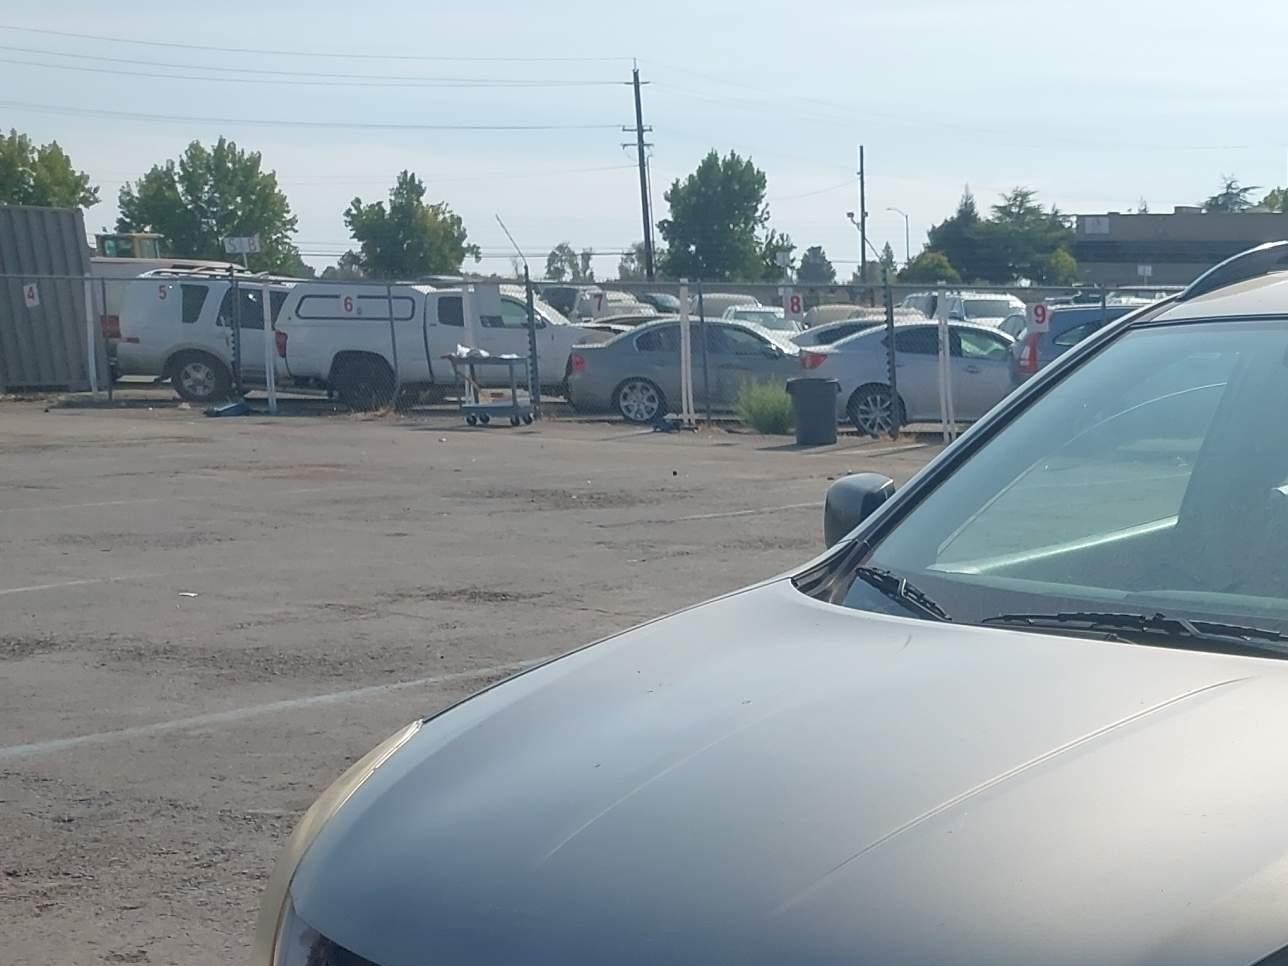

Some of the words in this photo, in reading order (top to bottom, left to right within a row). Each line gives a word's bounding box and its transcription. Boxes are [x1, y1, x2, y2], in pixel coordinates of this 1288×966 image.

[26, 286, 35, 300] 4
[158, 285, 167, 300] 5
[343, 296, 353, 312] 6
[592, 294, 604, 311] 7
[789, 295, 801, 314] 8
[1033, 304, 1047, 324] 9
